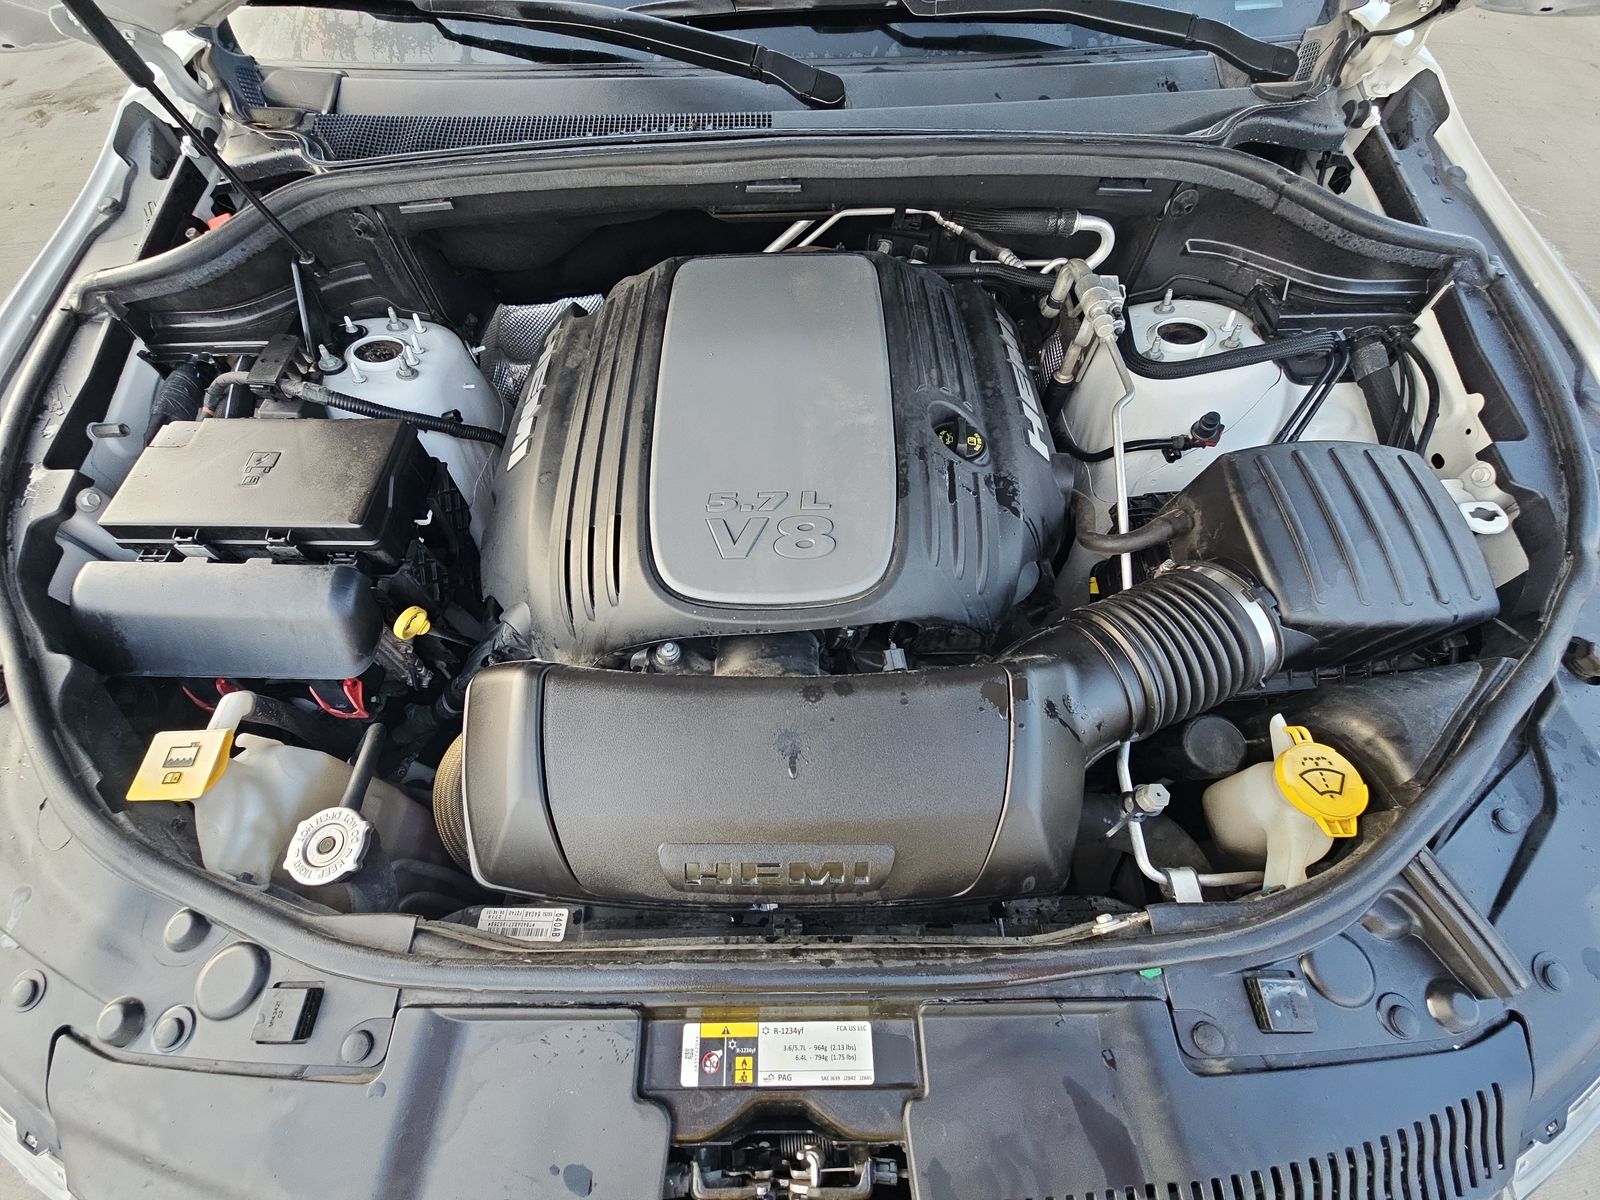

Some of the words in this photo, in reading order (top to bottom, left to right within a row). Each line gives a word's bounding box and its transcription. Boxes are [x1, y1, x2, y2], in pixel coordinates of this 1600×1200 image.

[995, 308, 1050, 462] HEMI
[706, 491, 789, 512] 5.7
[800, 491, 832, 511] L
[705, 515, 837, 560] V8
[318, 859, 346, 879] KEEP
[684, 862, 870, 886] HEMI
[551, 912, 565, 938] 640AB
[773, 1026, 804, 1036] R-1234yf
[783, 1044, 806, 1052] 3.6/5.7L
[813, 1044, 828, 1052] 964g
[830, 1044, 845, 1052] (2.13
[845, 1044, 857, 1052] lbs)
[815, 1054, 829, 1062] 794g
[830, 1053, 846, 1062] (1.75
[846, 1053, 857, 1062] lbs)
[777, 1073, 793, 1082] PAG
